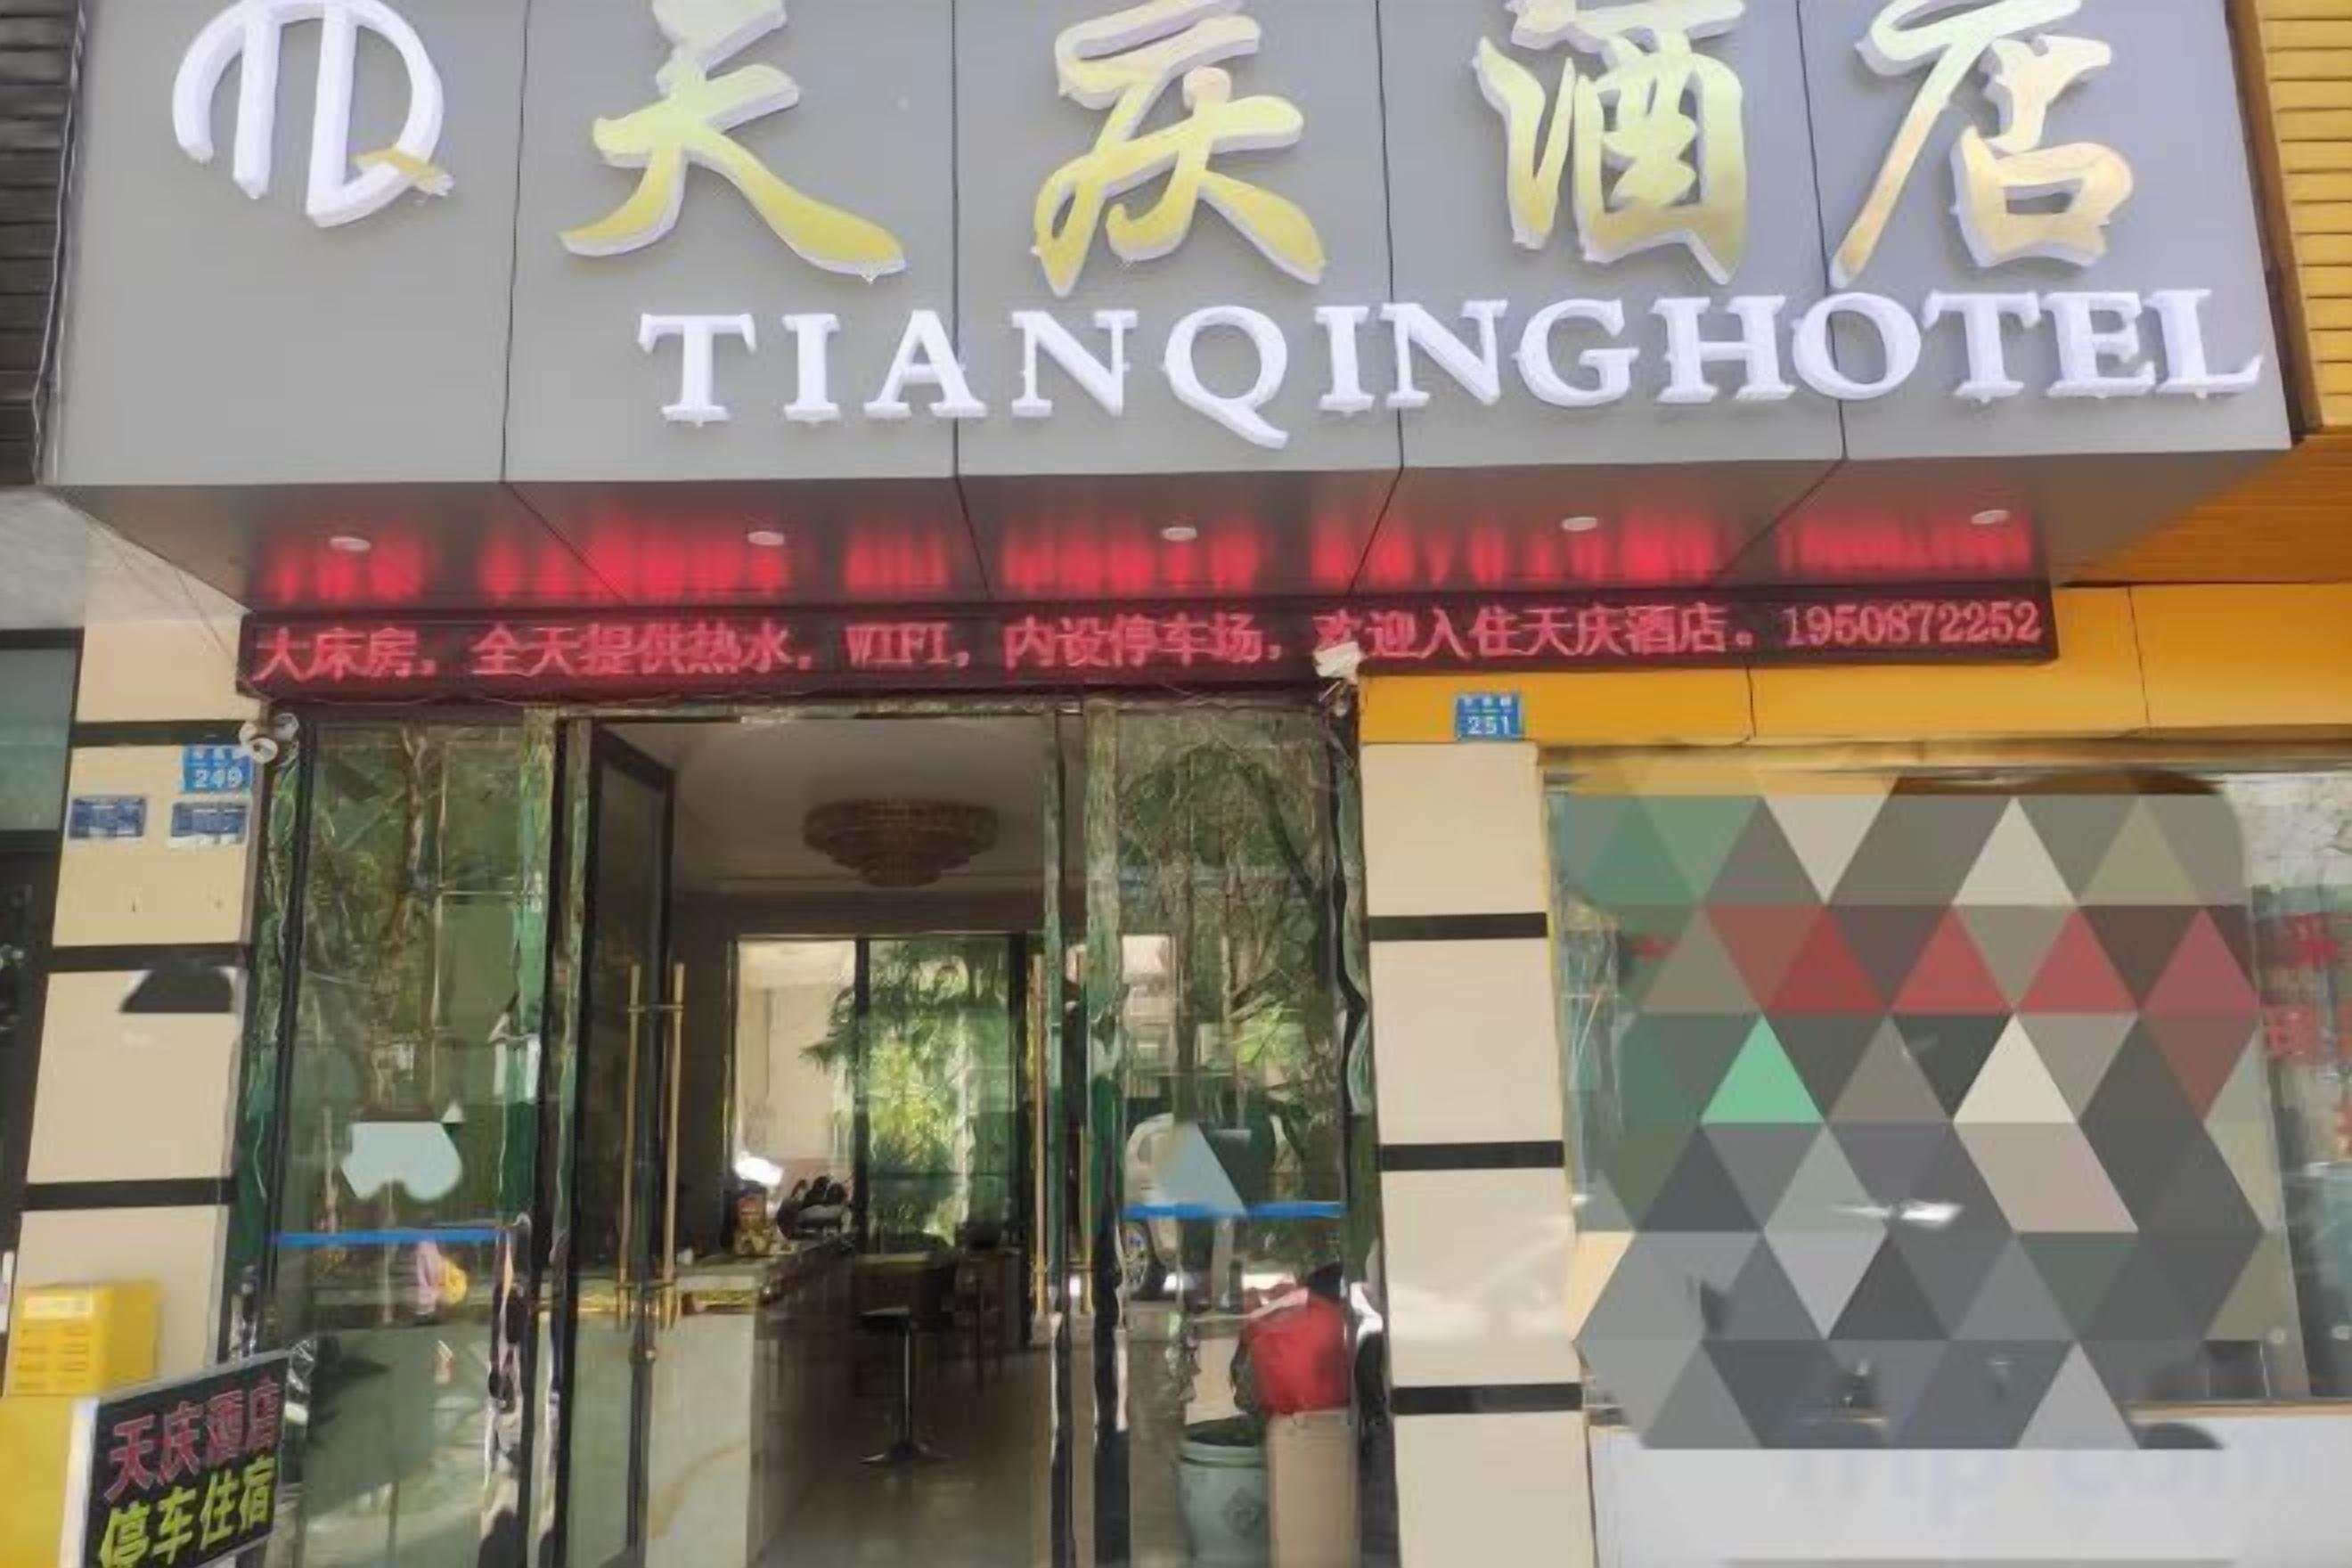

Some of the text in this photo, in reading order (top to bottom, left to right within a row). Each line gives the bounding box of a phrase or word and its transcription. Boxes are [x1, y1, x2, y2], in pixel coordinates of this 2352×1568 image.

[559, 0, 2135, 296] 天庆酒店
[1782, 600, 2043, 648] 1950872252
[1467, 715, 1510, 735] 251
[99, 1454, 275, 1568] 停车住宿
